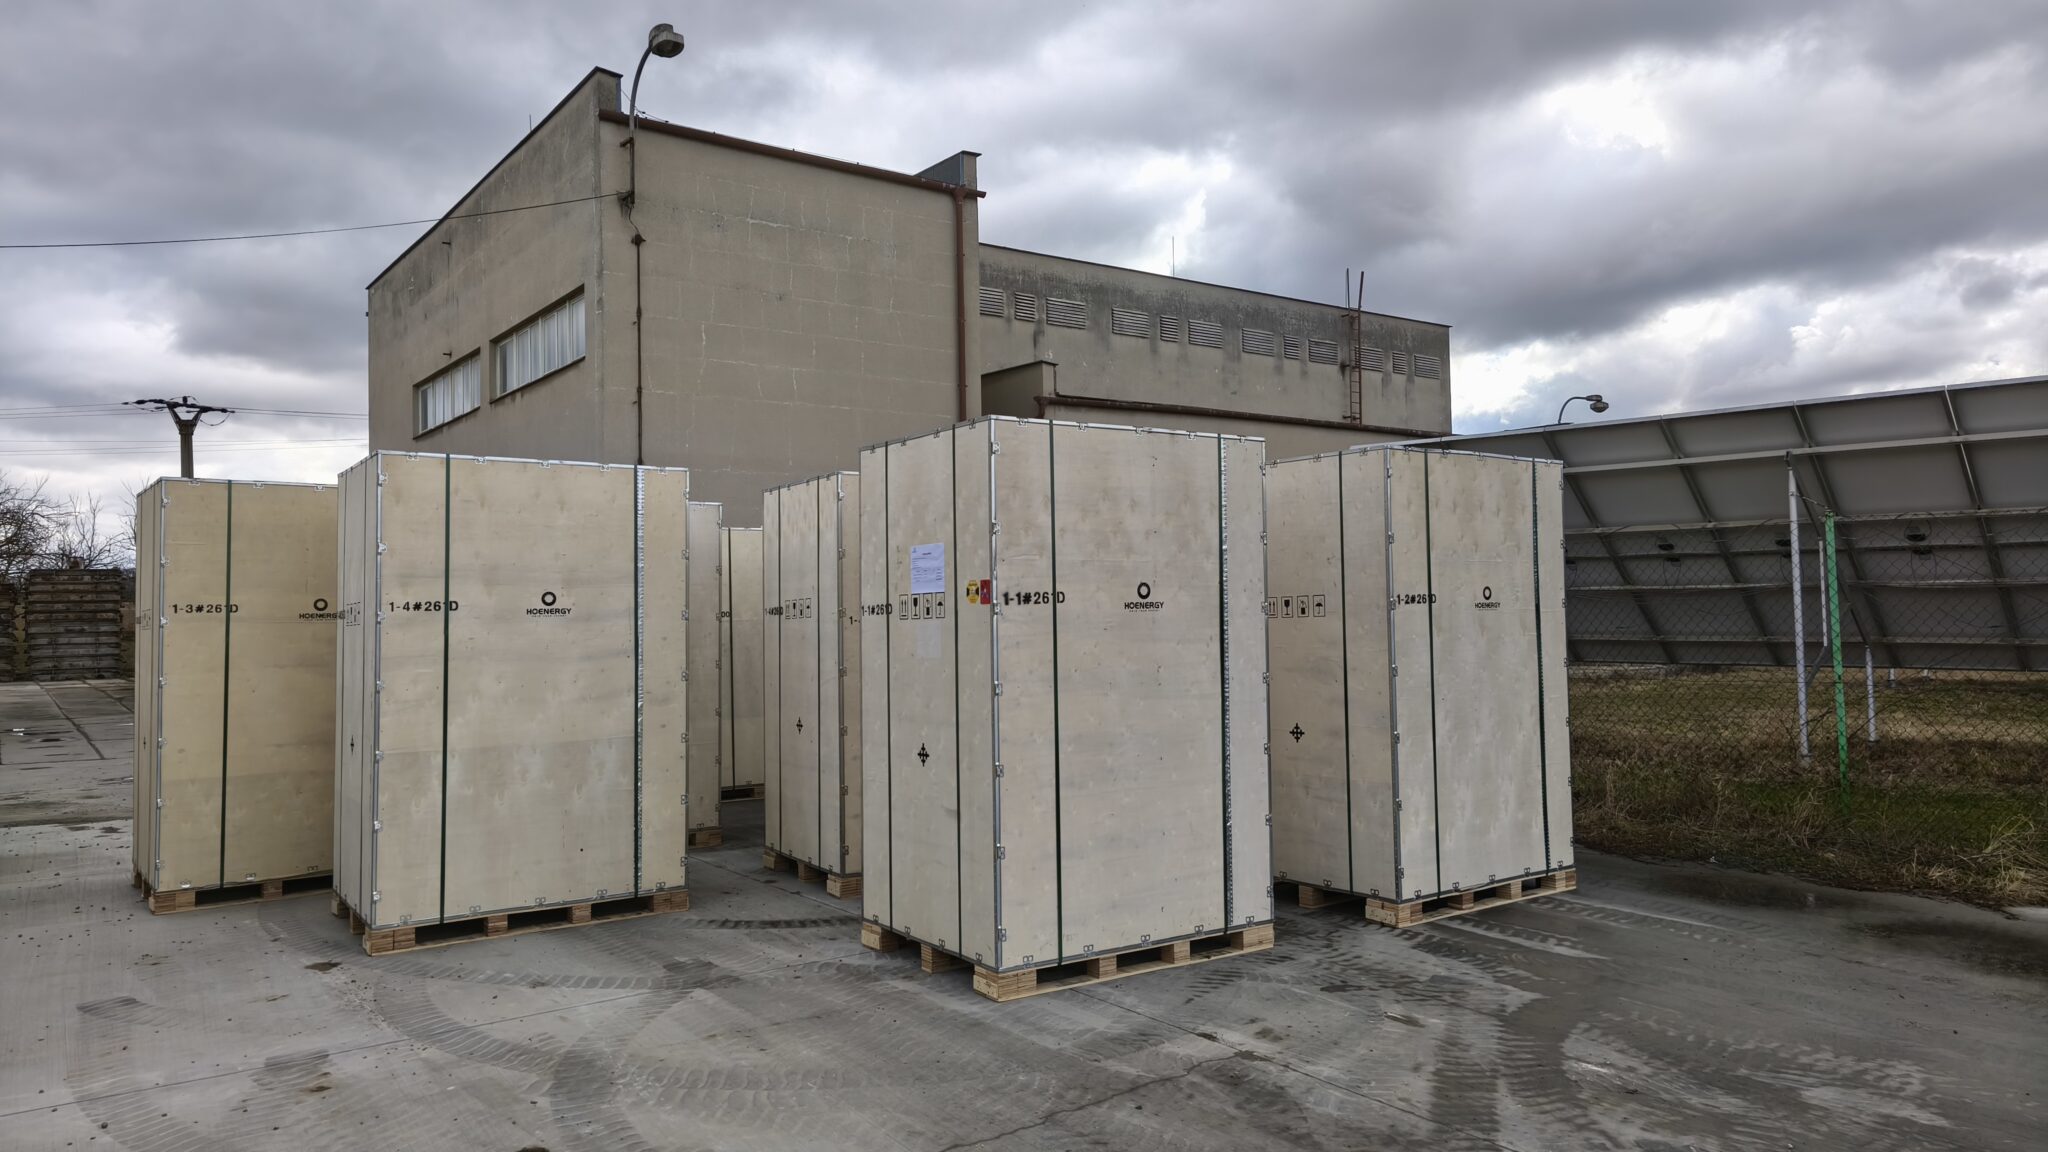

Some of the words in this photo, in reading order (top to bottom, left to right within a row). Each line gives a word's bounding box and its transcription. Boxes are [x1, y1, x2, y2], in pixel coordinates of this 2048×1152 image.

[1003, 591, 1065, 606] 1-1#26D
[172, 603, 239, 614] 1-3#26D
[389, 600, 459, 612] 1-4#26D
[1124, 601, 1164, 609] HOENERGY
[526, 607, 572, 615] HOENERGY
